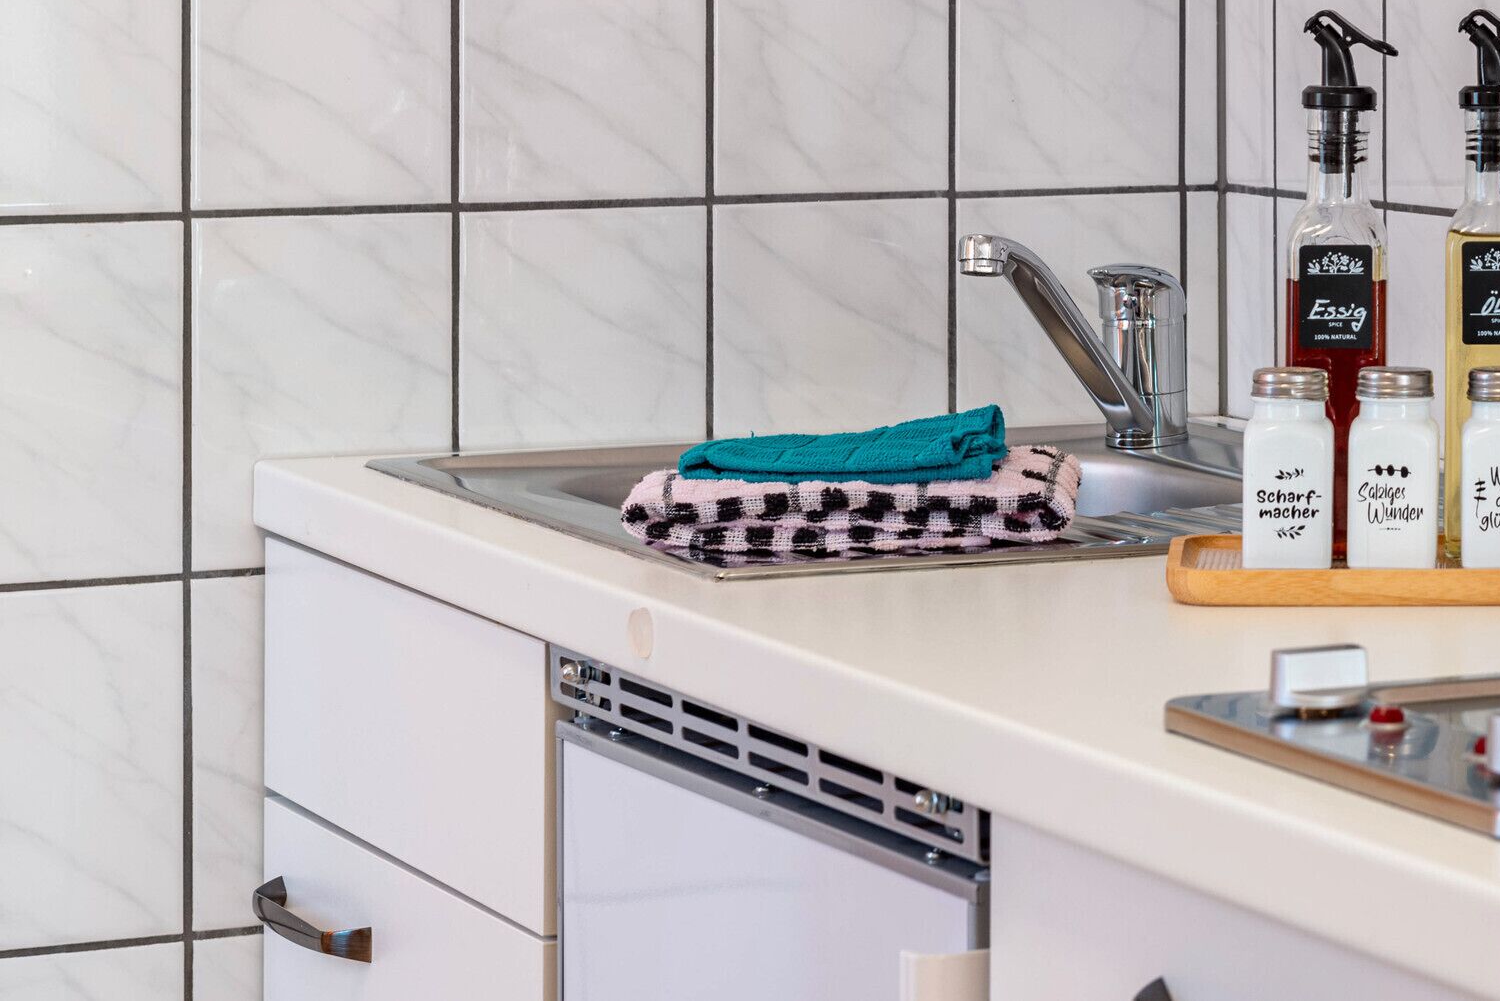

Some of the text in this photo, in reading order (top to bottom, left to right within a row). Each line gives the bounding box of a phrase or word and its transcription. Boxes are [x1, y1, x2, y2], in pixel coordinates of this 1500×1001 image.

[1309, 299, 1367, 332] Essig
[1256, 489, 1322, 505] Scharf-
[1357, 482, 1406, 506] Salziges
[1259, 505, 1320, 519] macher
[1367, 502, 1424, 524] Wunder
